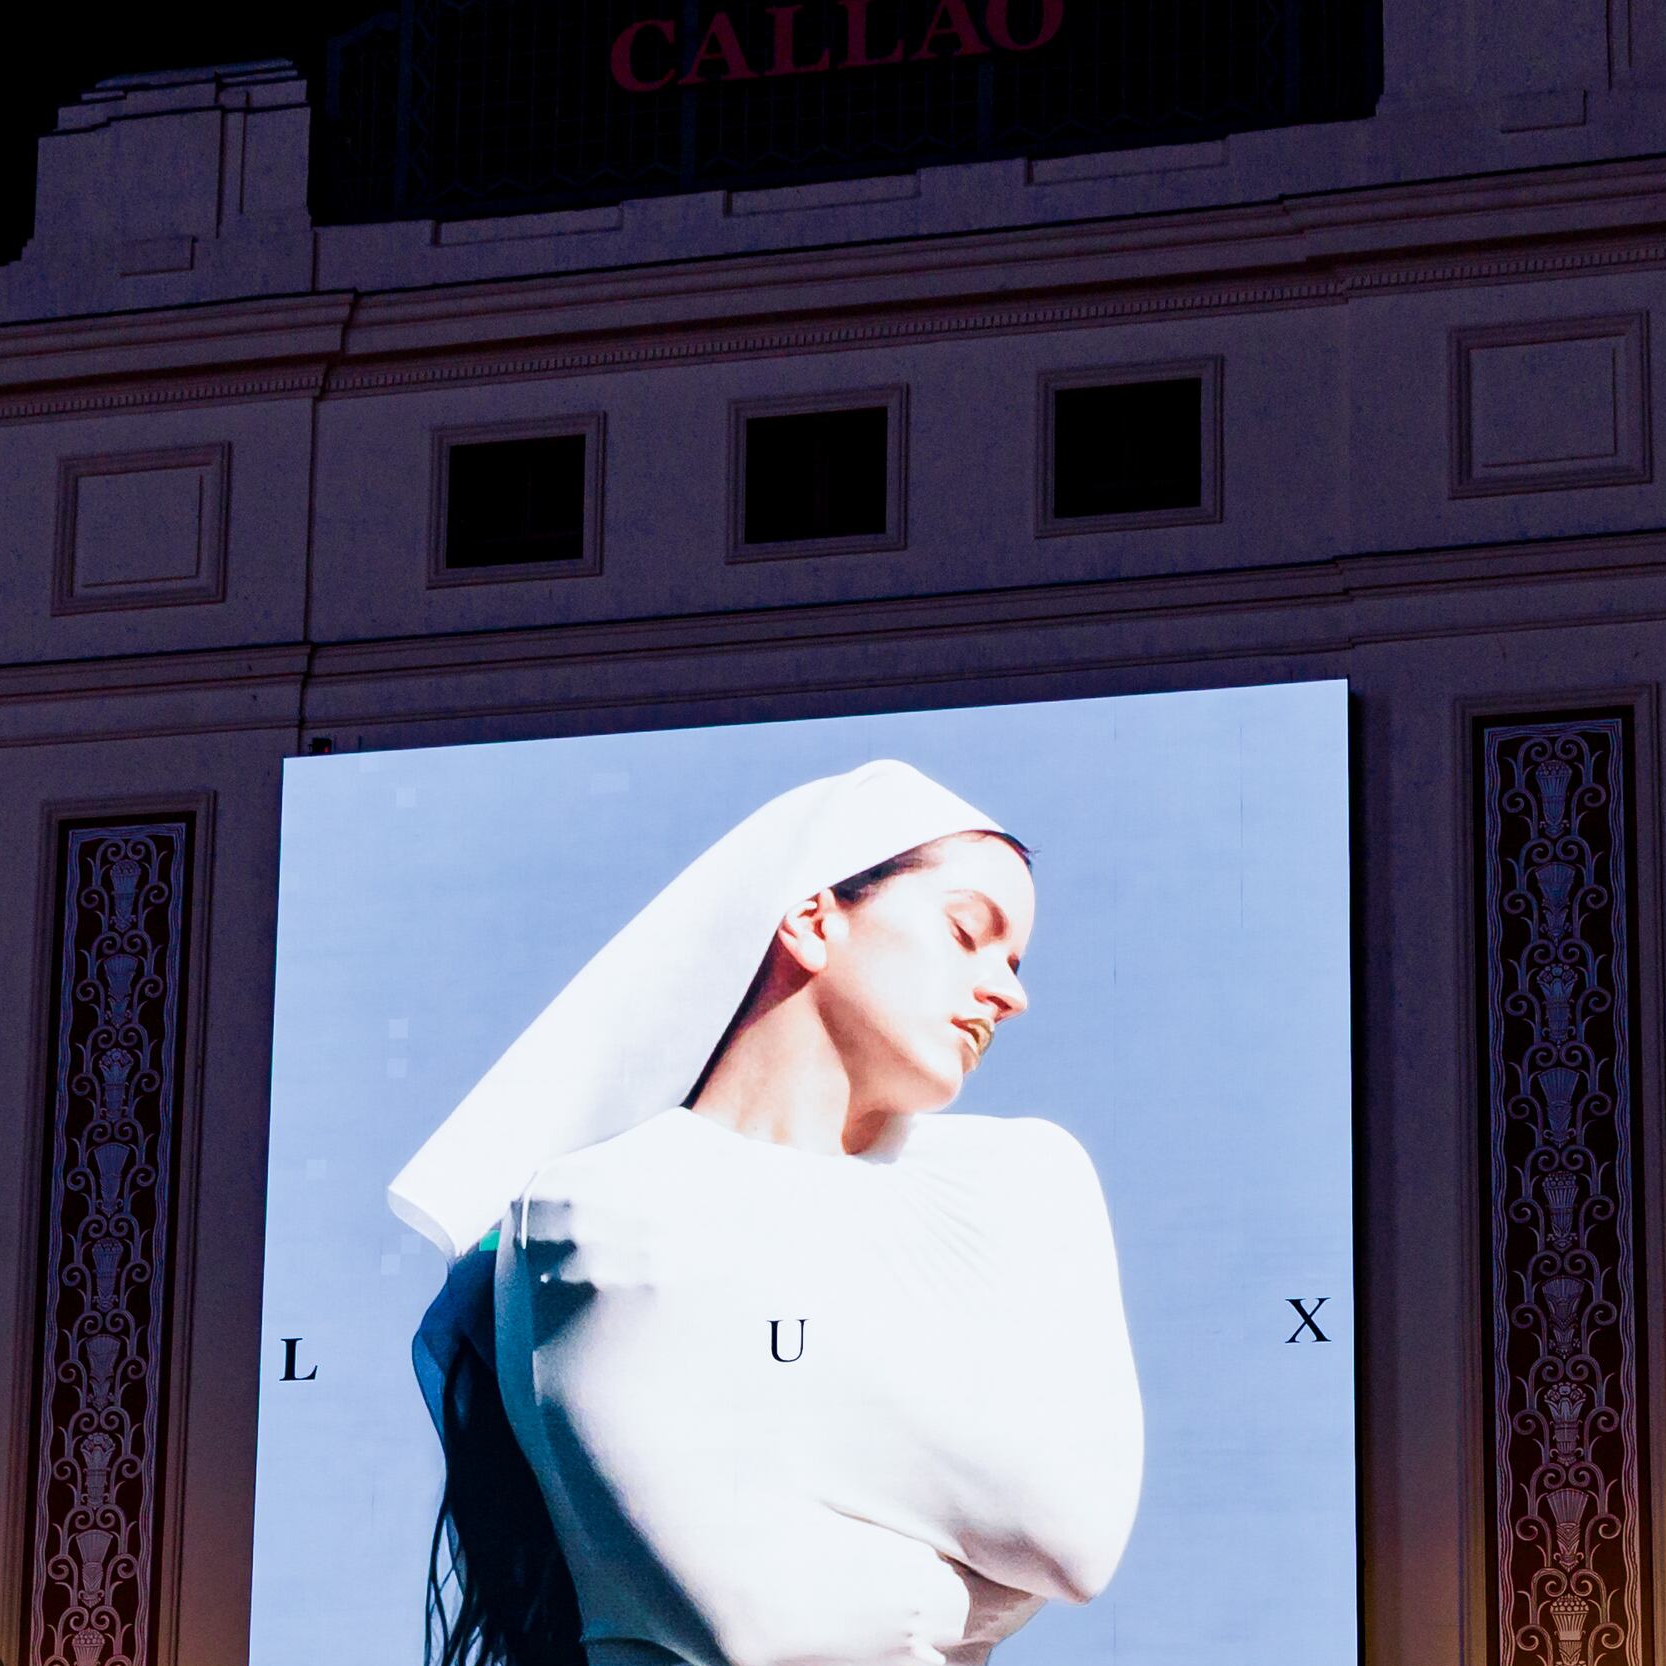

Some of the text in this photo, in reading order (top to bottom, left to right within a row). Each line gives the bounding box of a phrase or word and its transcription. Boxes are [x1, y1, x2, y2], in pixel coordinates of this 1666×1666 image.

[610, 0, 1064, 92] CALLAO
[279, 1297, 1332, 1381] L U X
